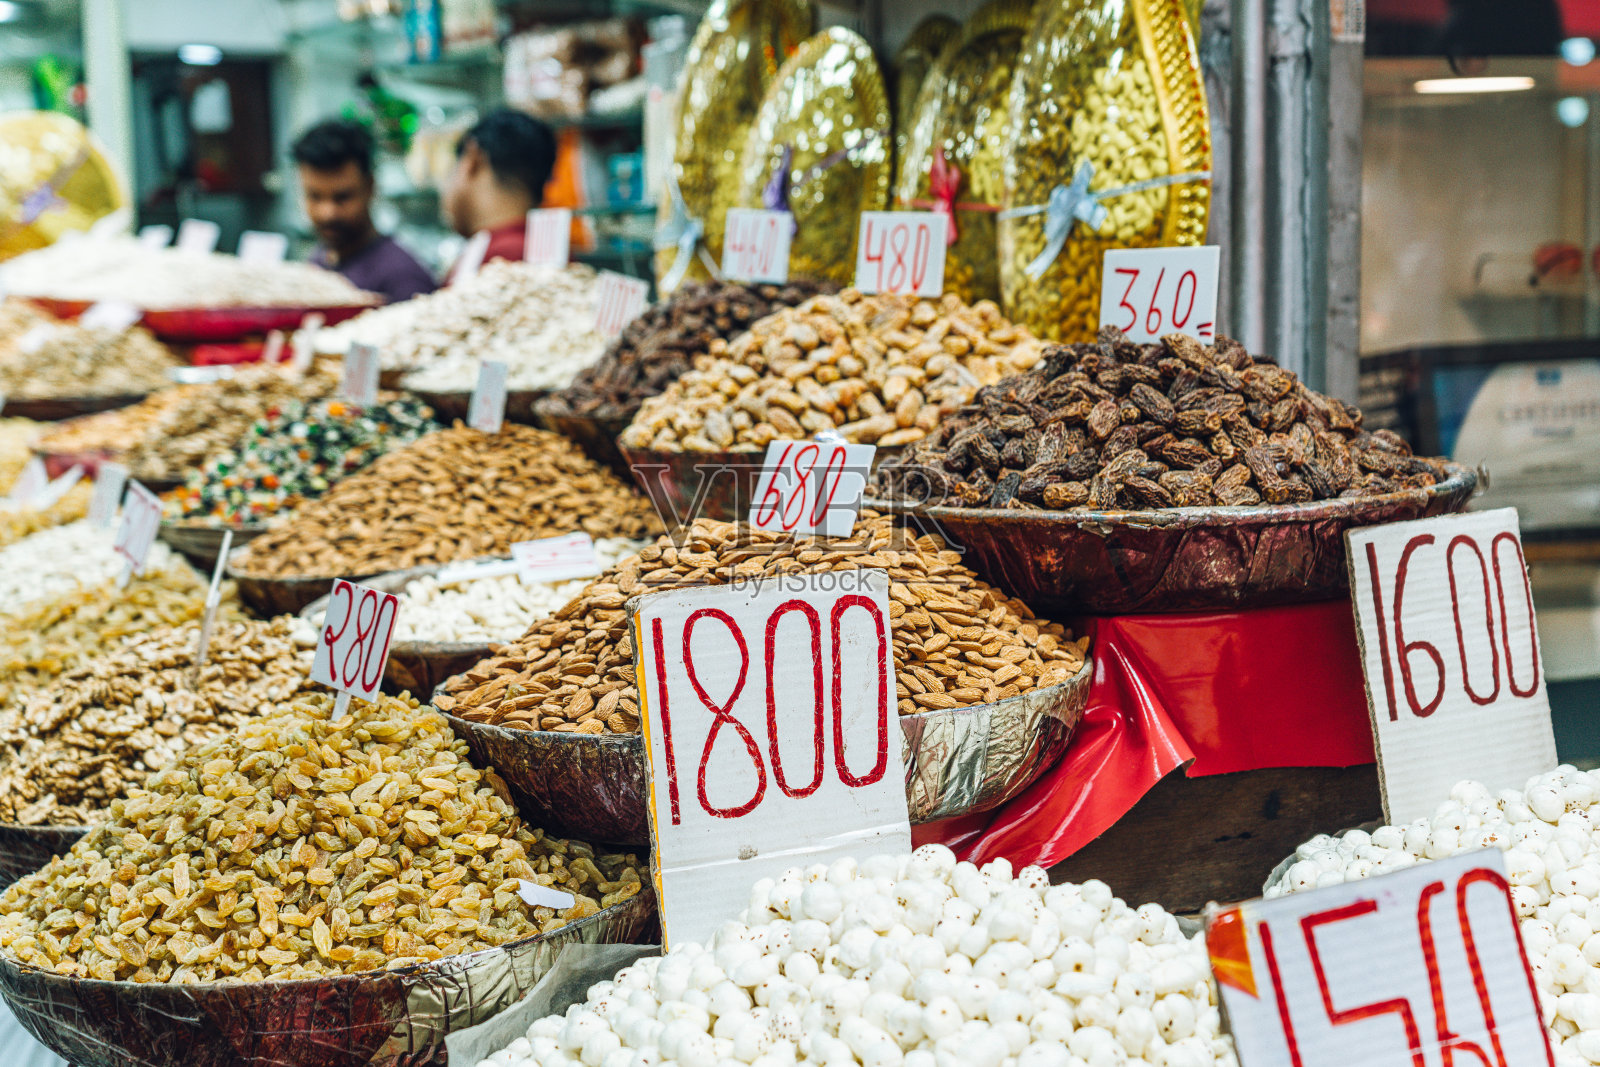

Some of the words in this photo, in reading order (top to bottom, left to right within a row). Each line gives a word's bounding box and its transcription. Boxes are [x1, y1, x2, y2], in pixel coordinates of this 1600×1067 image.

[864, 219, 931, 295] 480
[755, 443, 847, 532] 680
[1365, 531, 1540, 722] 1600
[651, 594, 889, 826] 1800
